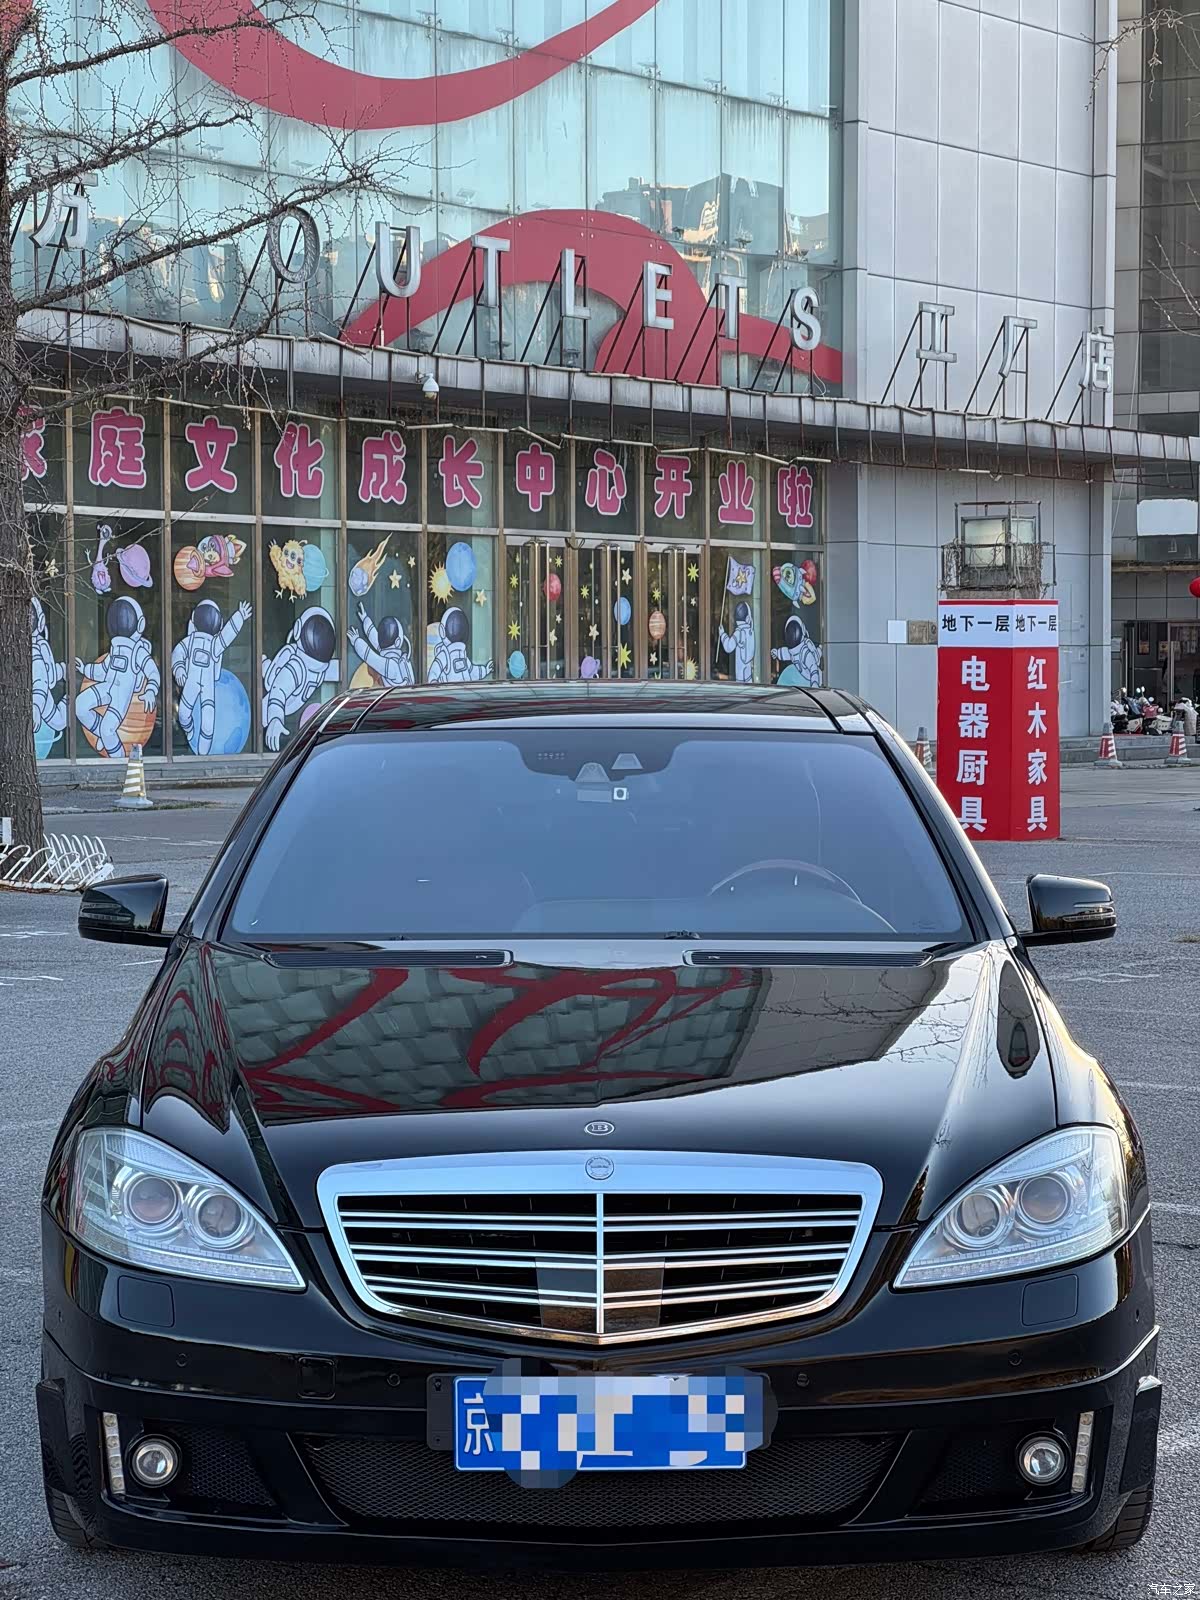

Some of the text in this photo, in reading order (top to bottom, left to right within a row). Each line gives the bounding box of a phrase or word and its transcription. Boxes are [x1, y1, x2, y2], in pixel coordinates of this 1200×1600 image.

[267, 206, 821, 351] OUTLETS
[915, 301, 1114, 393] 工厂店
[941, 614, 1010, 633] 地下一层
[1015, 614, 1058, 633] 地下一层
[956, 655, 990, 833] 电器厨具
[1026, 655, 1048, 832] 红木家具
